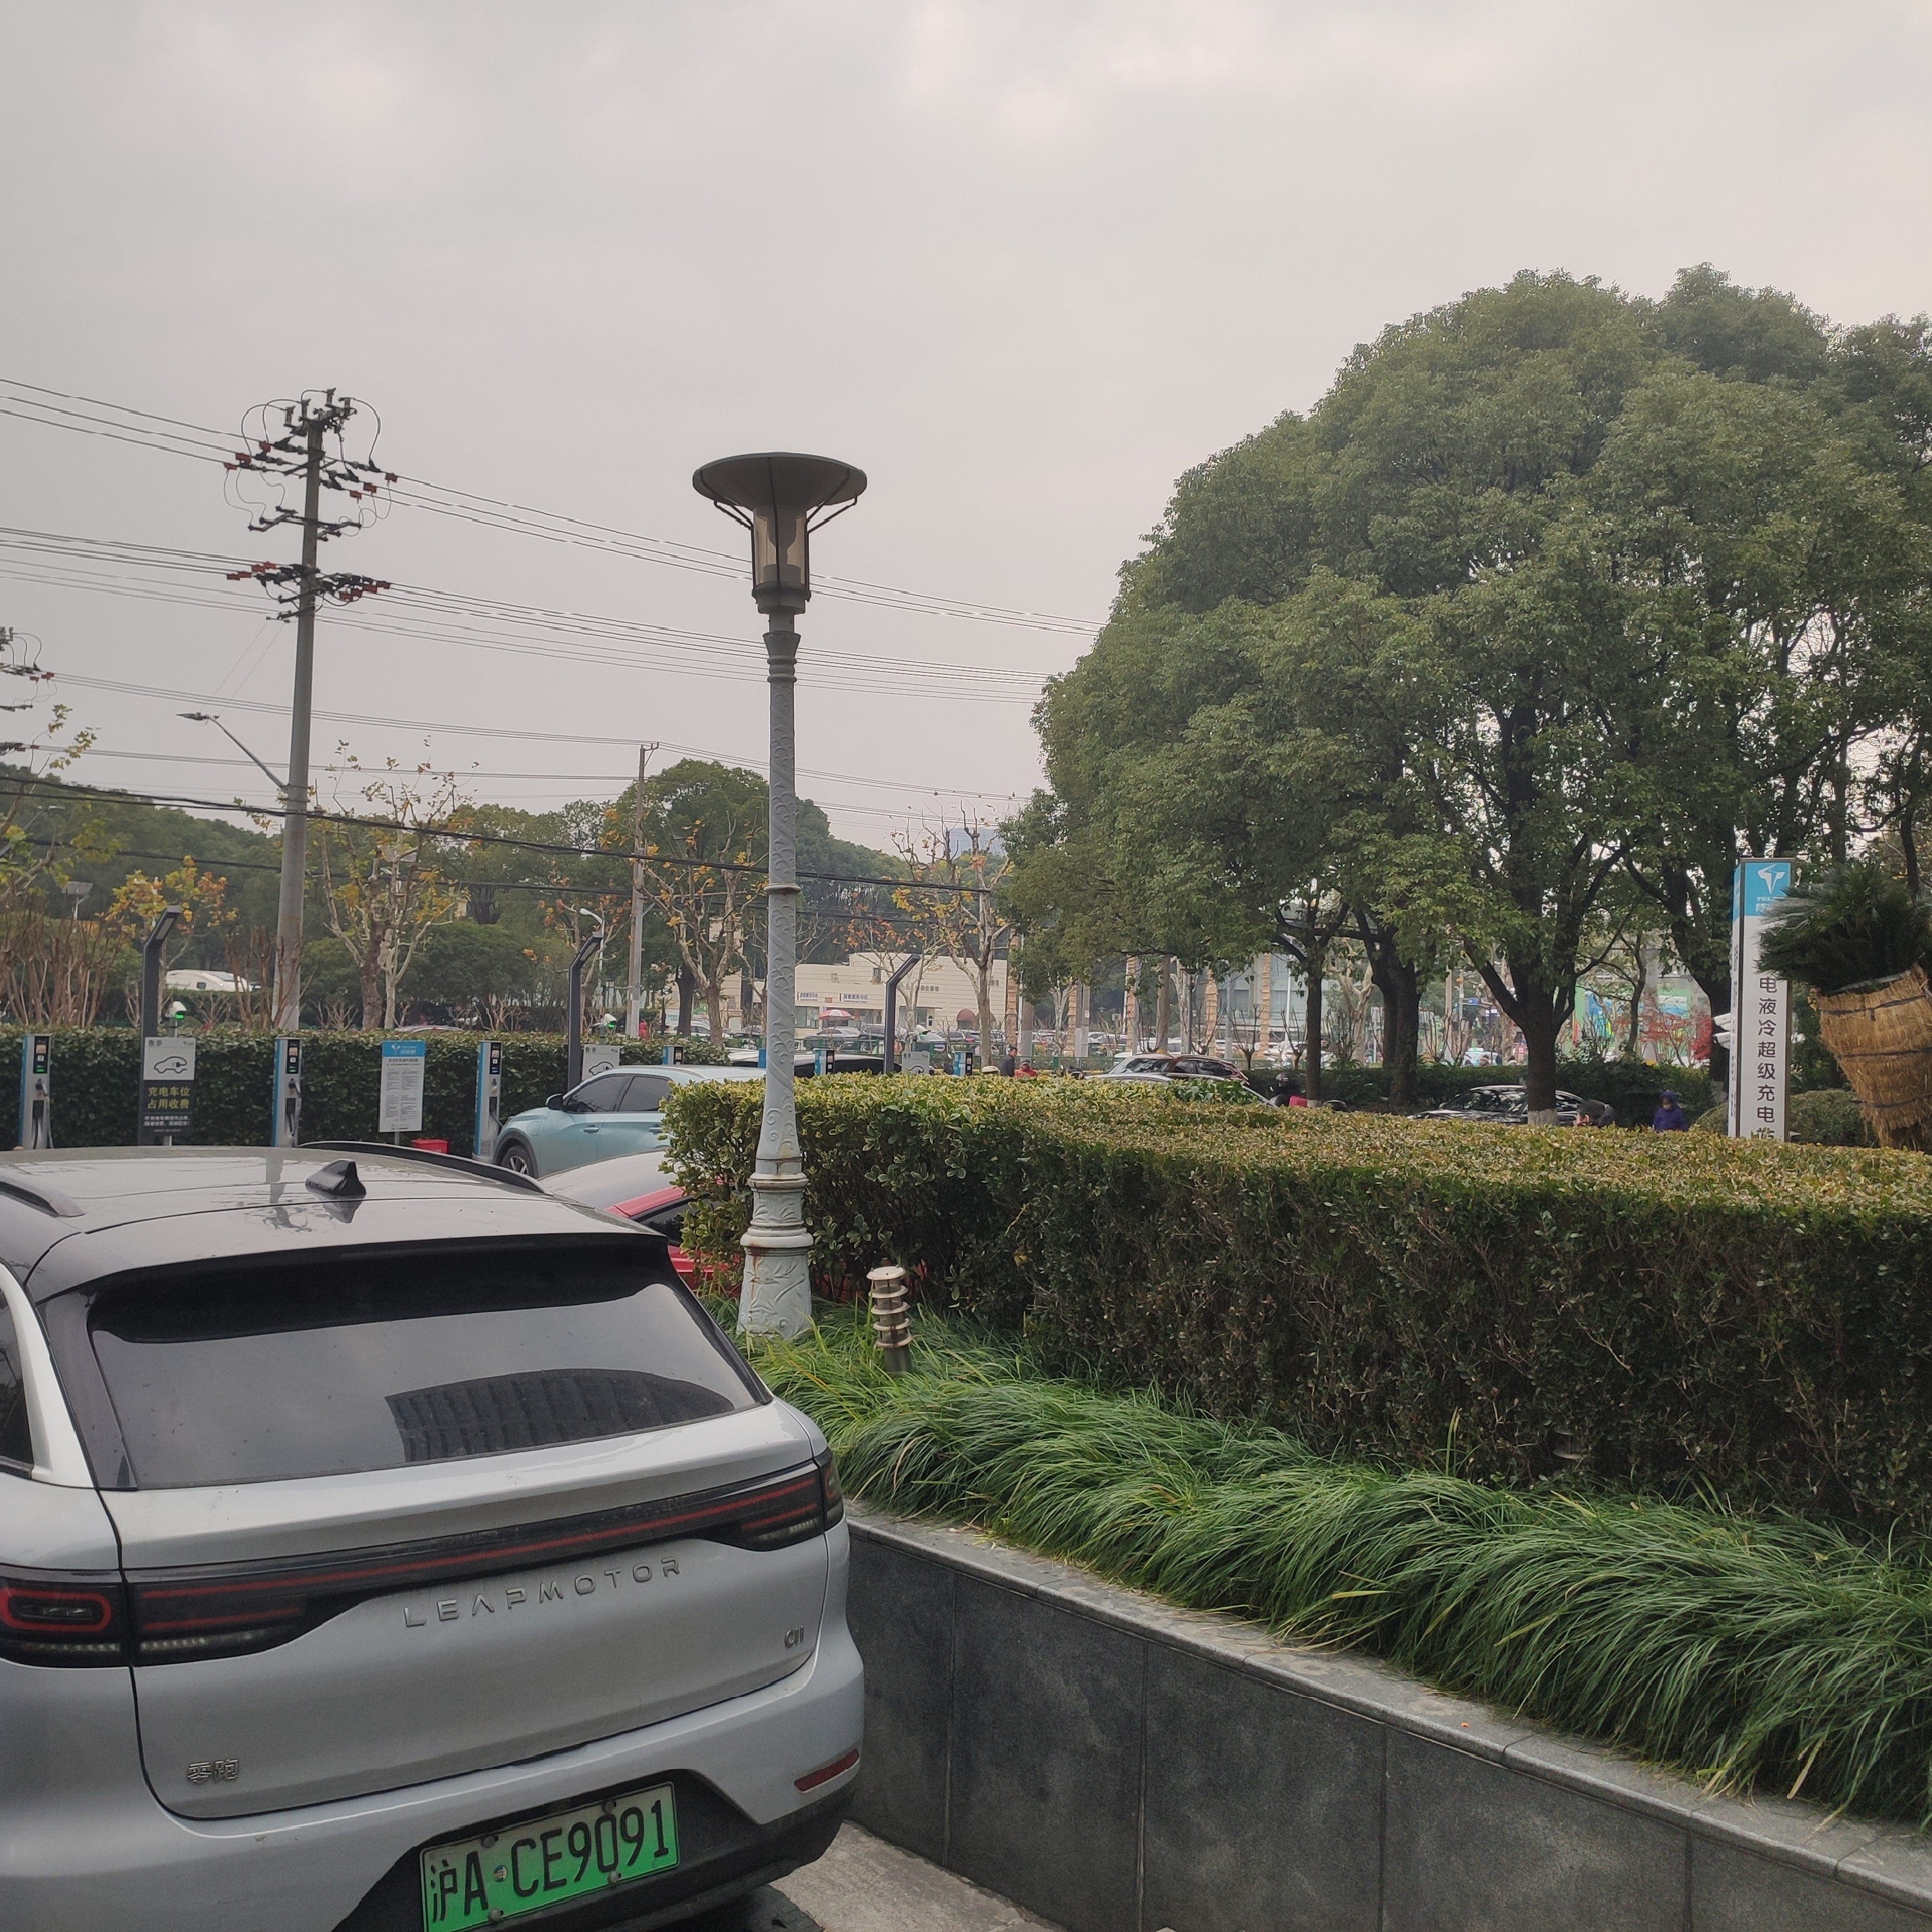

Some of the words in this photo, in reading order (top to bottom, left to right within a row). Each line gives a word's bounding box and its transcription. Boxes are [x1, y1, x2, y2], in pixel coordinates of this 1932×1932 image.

[148, 1086, 191, 1097] 充电车位
[147, 1099, 189, 1109] 占用收费
[404, 1557, 681, 1628] LEAPMOTOR
[187, 1759, 238, 1784] 零跑
